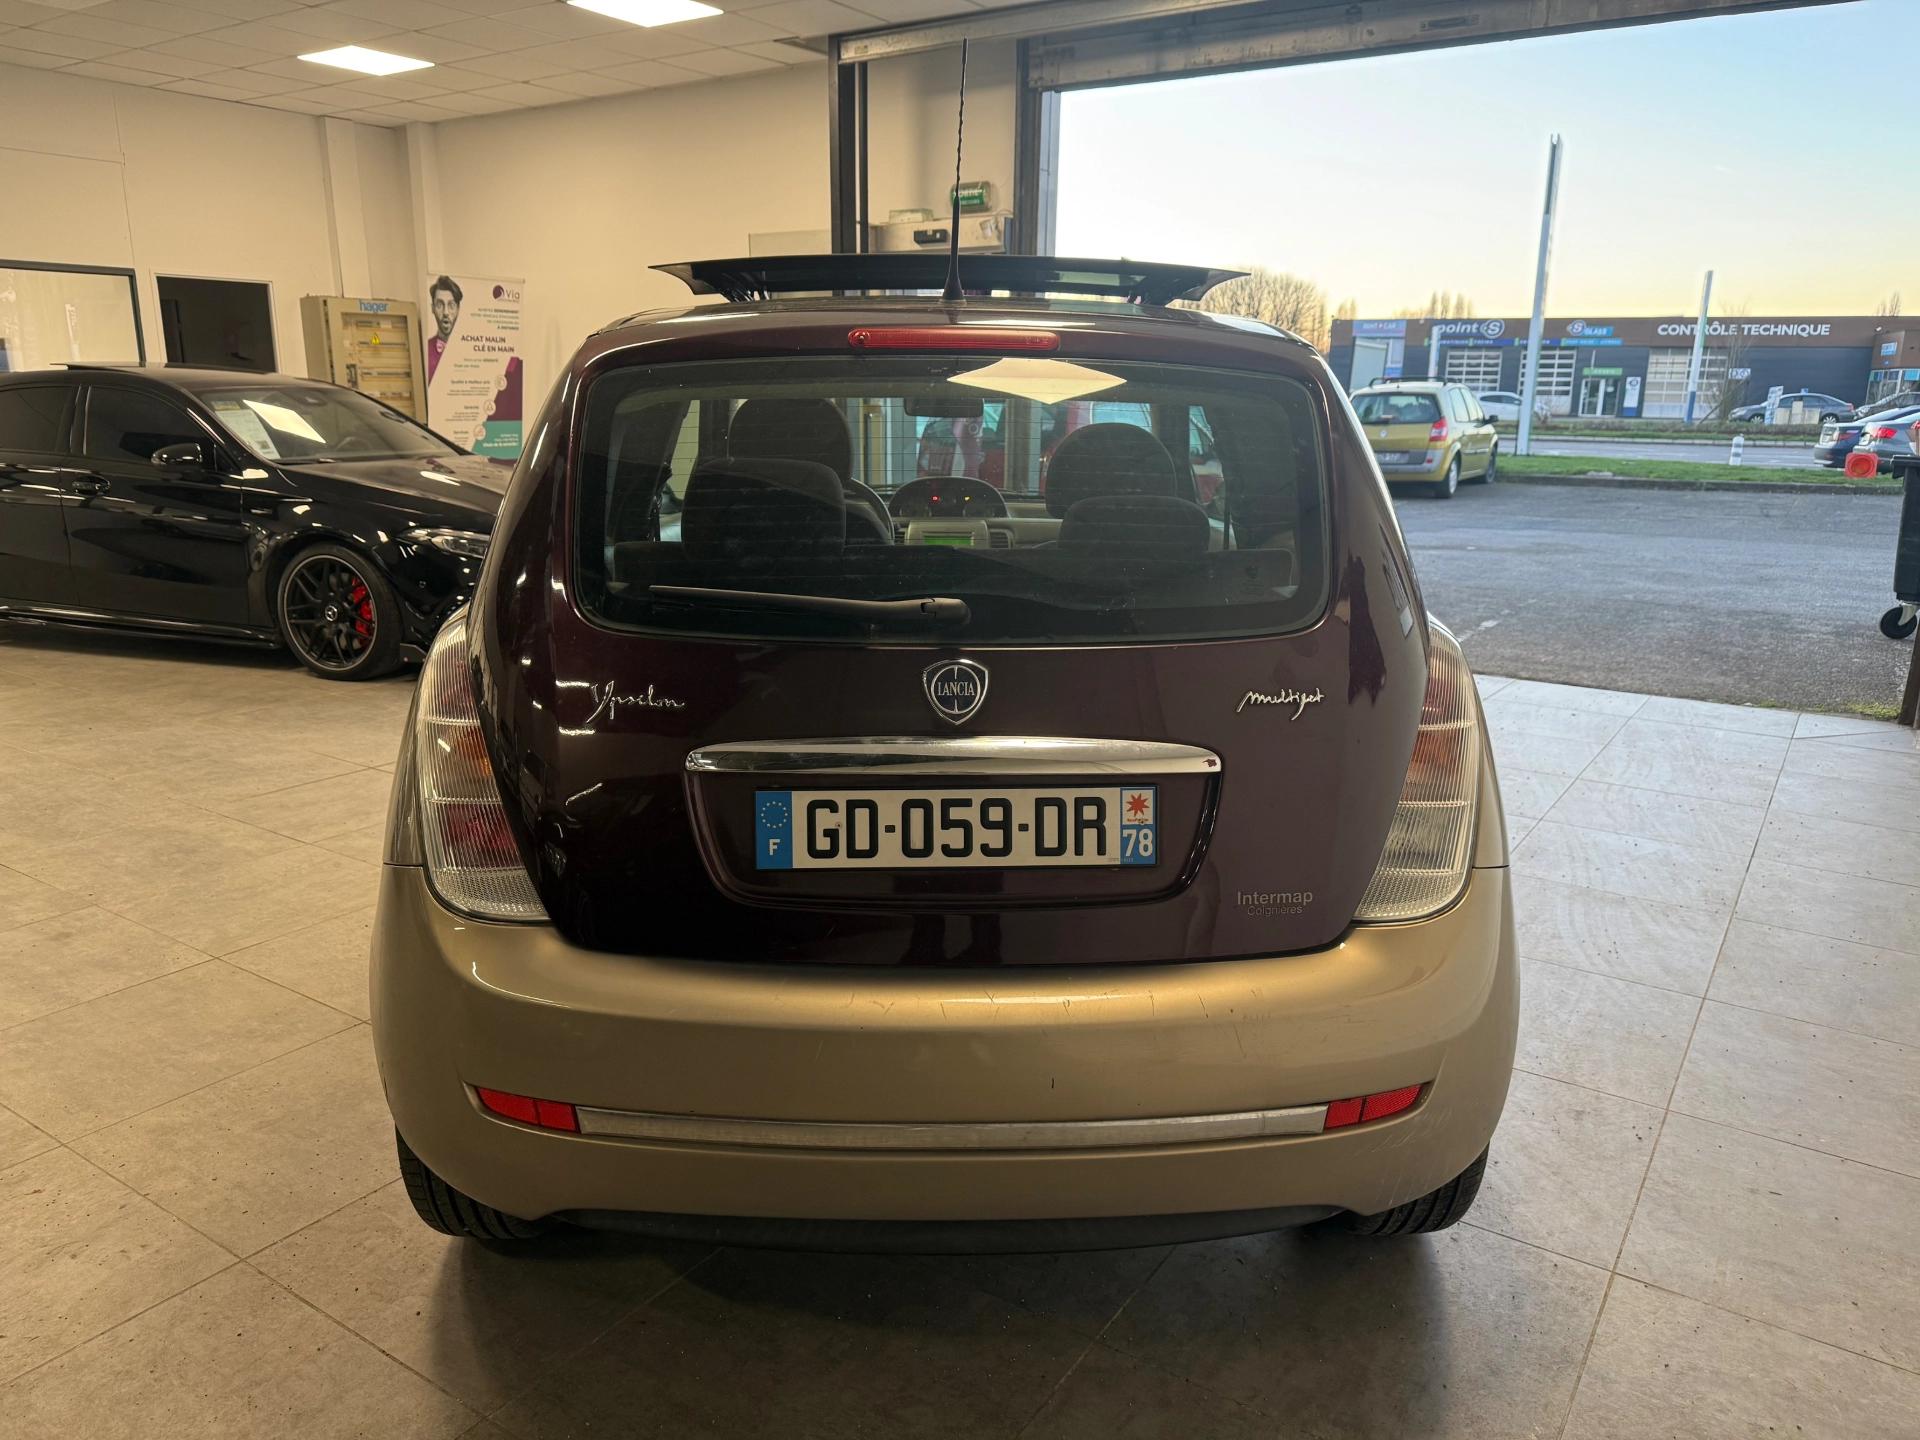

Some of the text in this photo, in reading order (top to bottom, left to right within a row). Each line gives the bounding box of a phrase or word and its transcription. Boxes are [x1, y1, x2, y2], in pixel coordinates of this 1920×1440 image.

[359, 300, 389, 312] hager
[1437, 321, 1479, 334] point
[1742, 324, 1831, 337] TECHNIQUE
[473, 344, 485, 352] CLÉ
[937, 681, 975, 696] LANCIA
[586, 680, 685, 723] Ypsilon
[806, 796, 1107, 860] GD-059-DR
[769, 838, 781, 856] F
[1122, 828, 1153, 857] 78
[1237, 890, 1313, 906] Intermap
